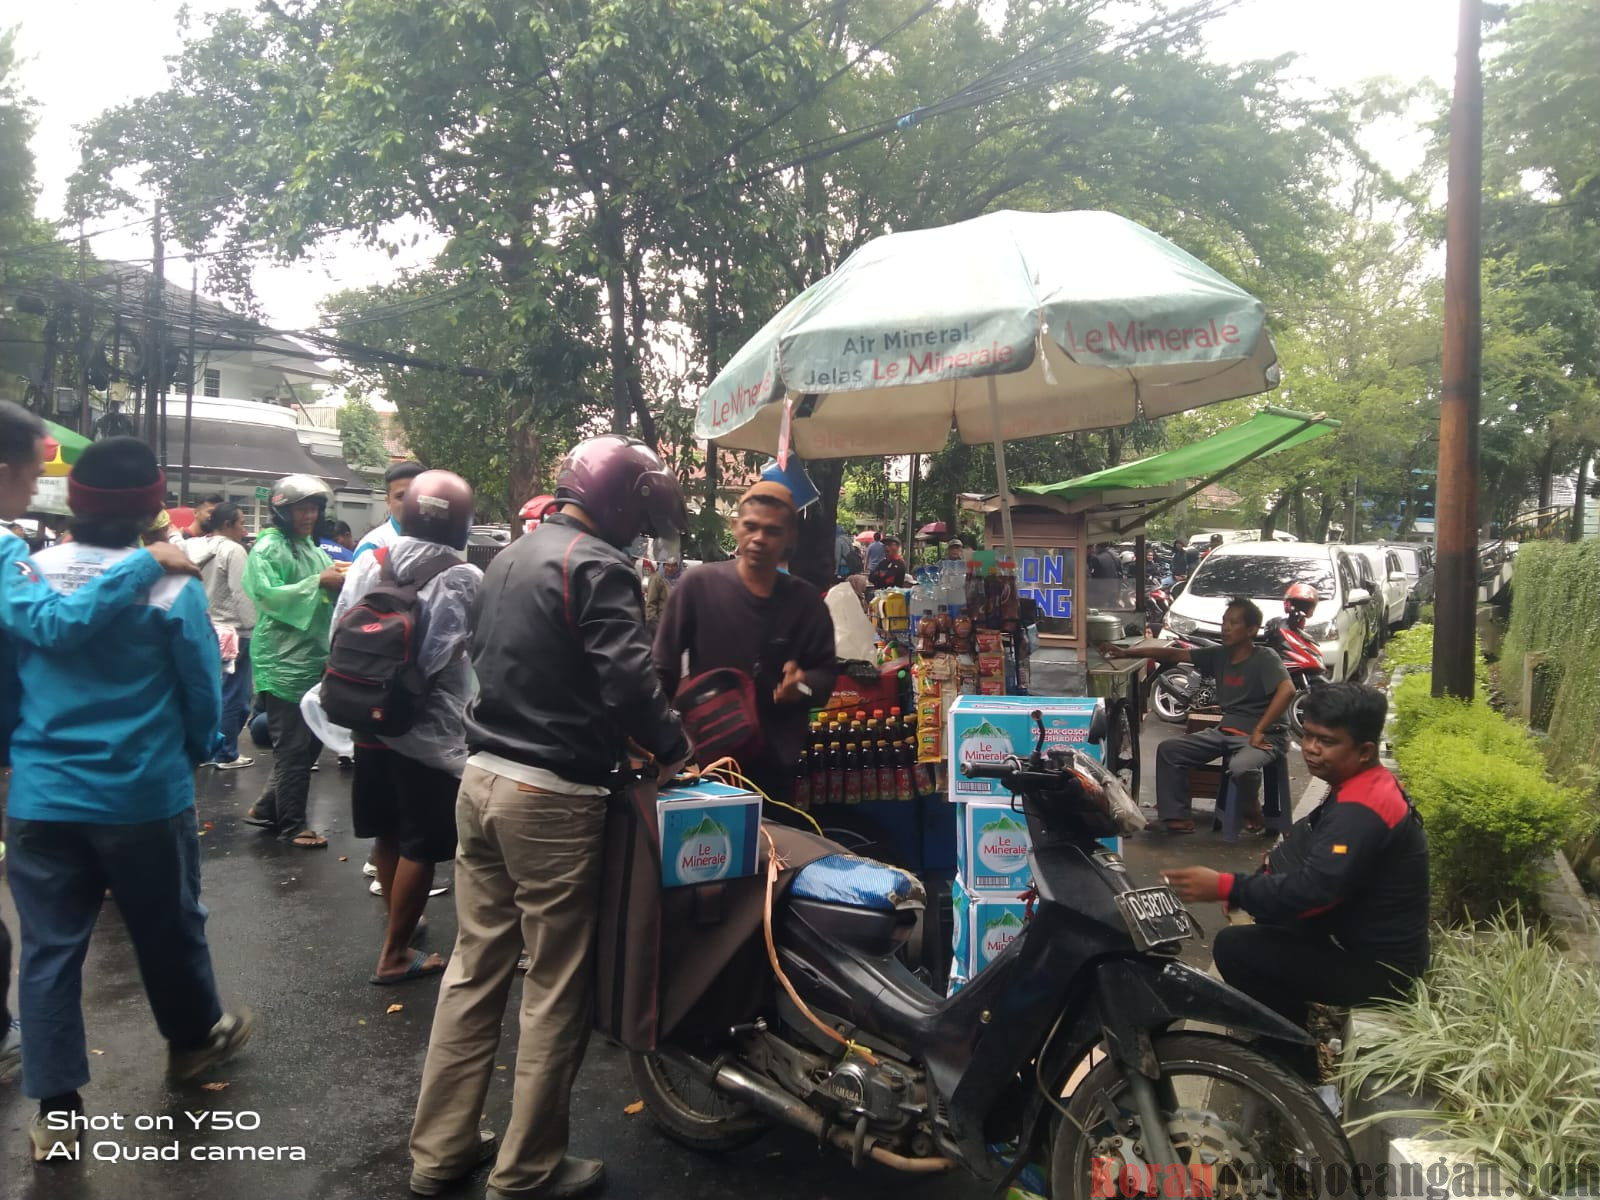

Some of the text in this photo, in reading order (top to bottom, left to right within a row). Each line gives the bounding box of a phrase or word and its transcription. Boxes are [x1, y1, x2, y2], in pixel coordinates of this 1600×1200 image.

[1066, 318, 1241, 353] Le Minerale
[842, 336, 876, 355] Air
[804, 341, 1014, 386] Jelas Le Minerale
[979, 742, 992, 752] Le
[999, 836, 1011, 846] Le
[698, 844, 711, 856] Le
[984, 845, 1027, 855] Minerale
[682, 854, 726, 869] Minerale
[1128, 896, 1146, 921] D
[1140, 892, 1174, 918] 5870
[1002, 932, 1015, 942] Le
